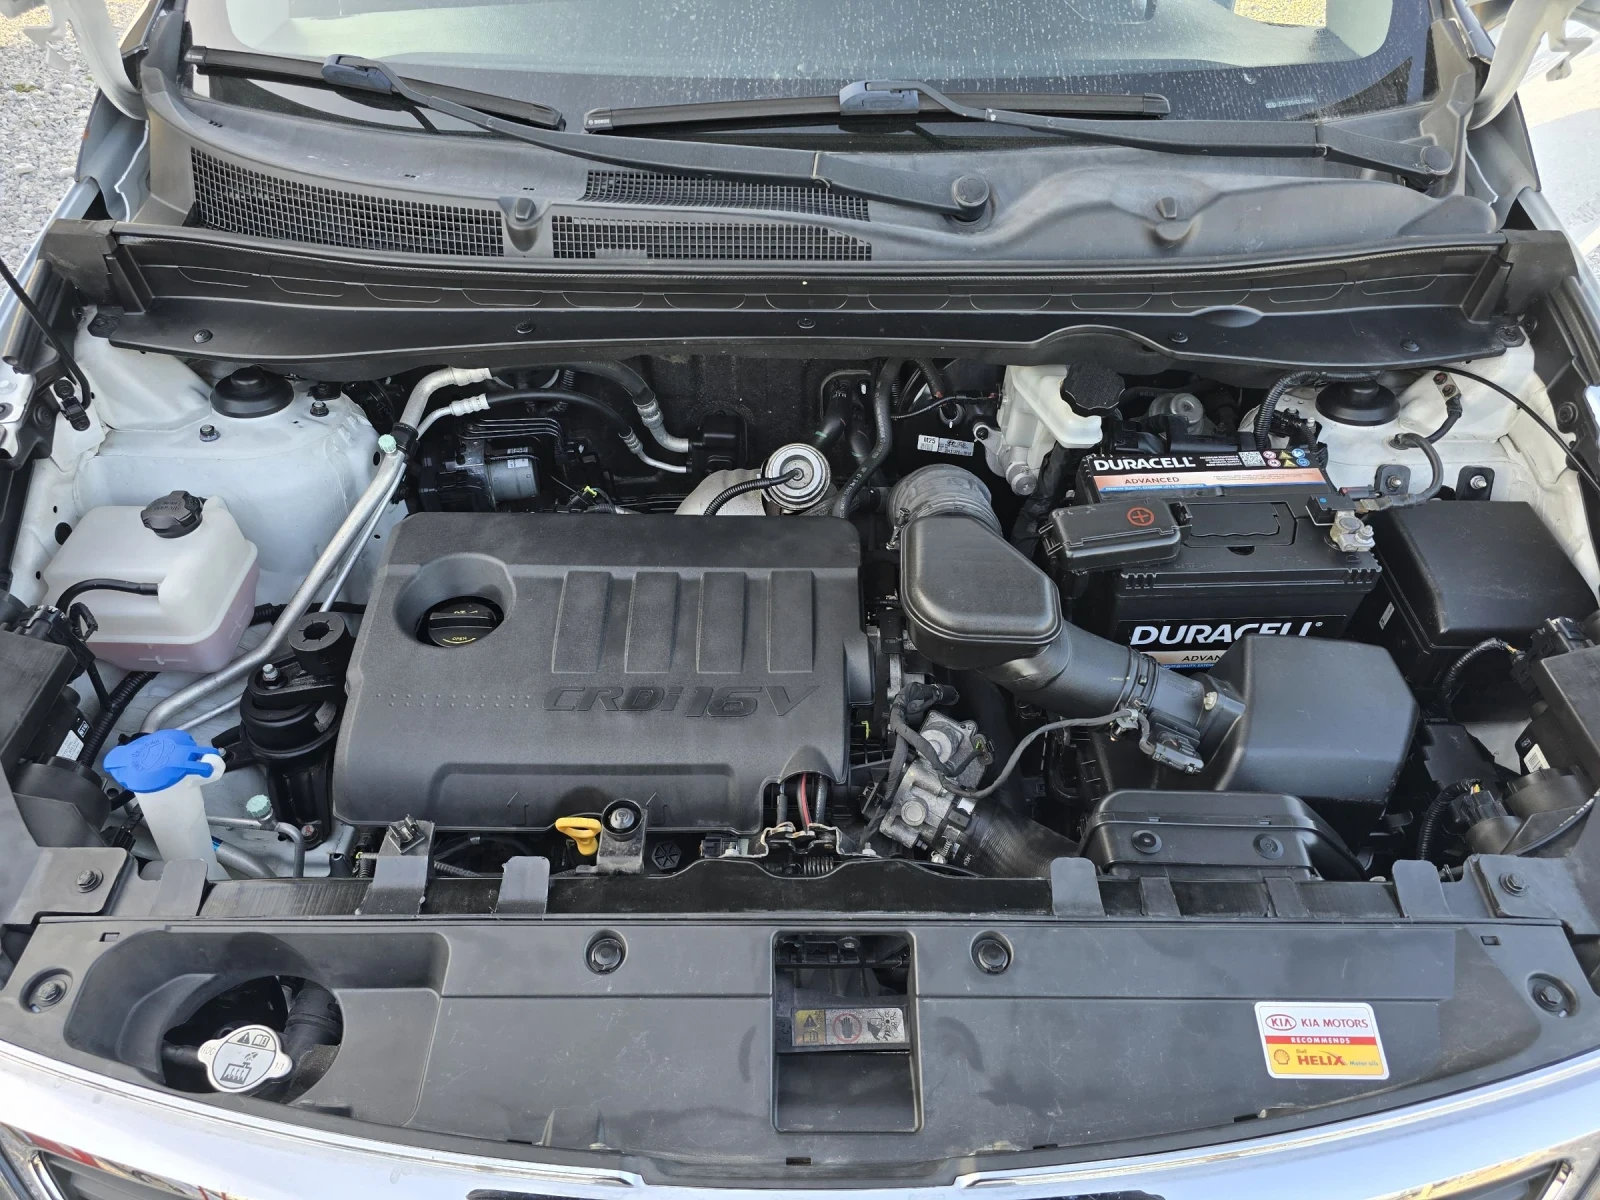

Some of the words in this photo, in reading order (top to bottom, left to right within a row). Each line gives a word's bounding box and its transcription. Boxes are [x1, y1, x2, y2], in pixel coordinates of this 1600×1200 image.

[1093, 457, 1196, 471] DURACELL
[1125, 477, 1180, 485] ADVANCED
[1271, 1018, 1292, 1027] KIA
[1301, 1018, 1320, 1028] KIA
[1323, 1018, 1369, 1029] MOTORS
[1290, 1036, 1350, 1044] RECOMMENDS
[1297, 1055, 1346, 1066] HELIX
